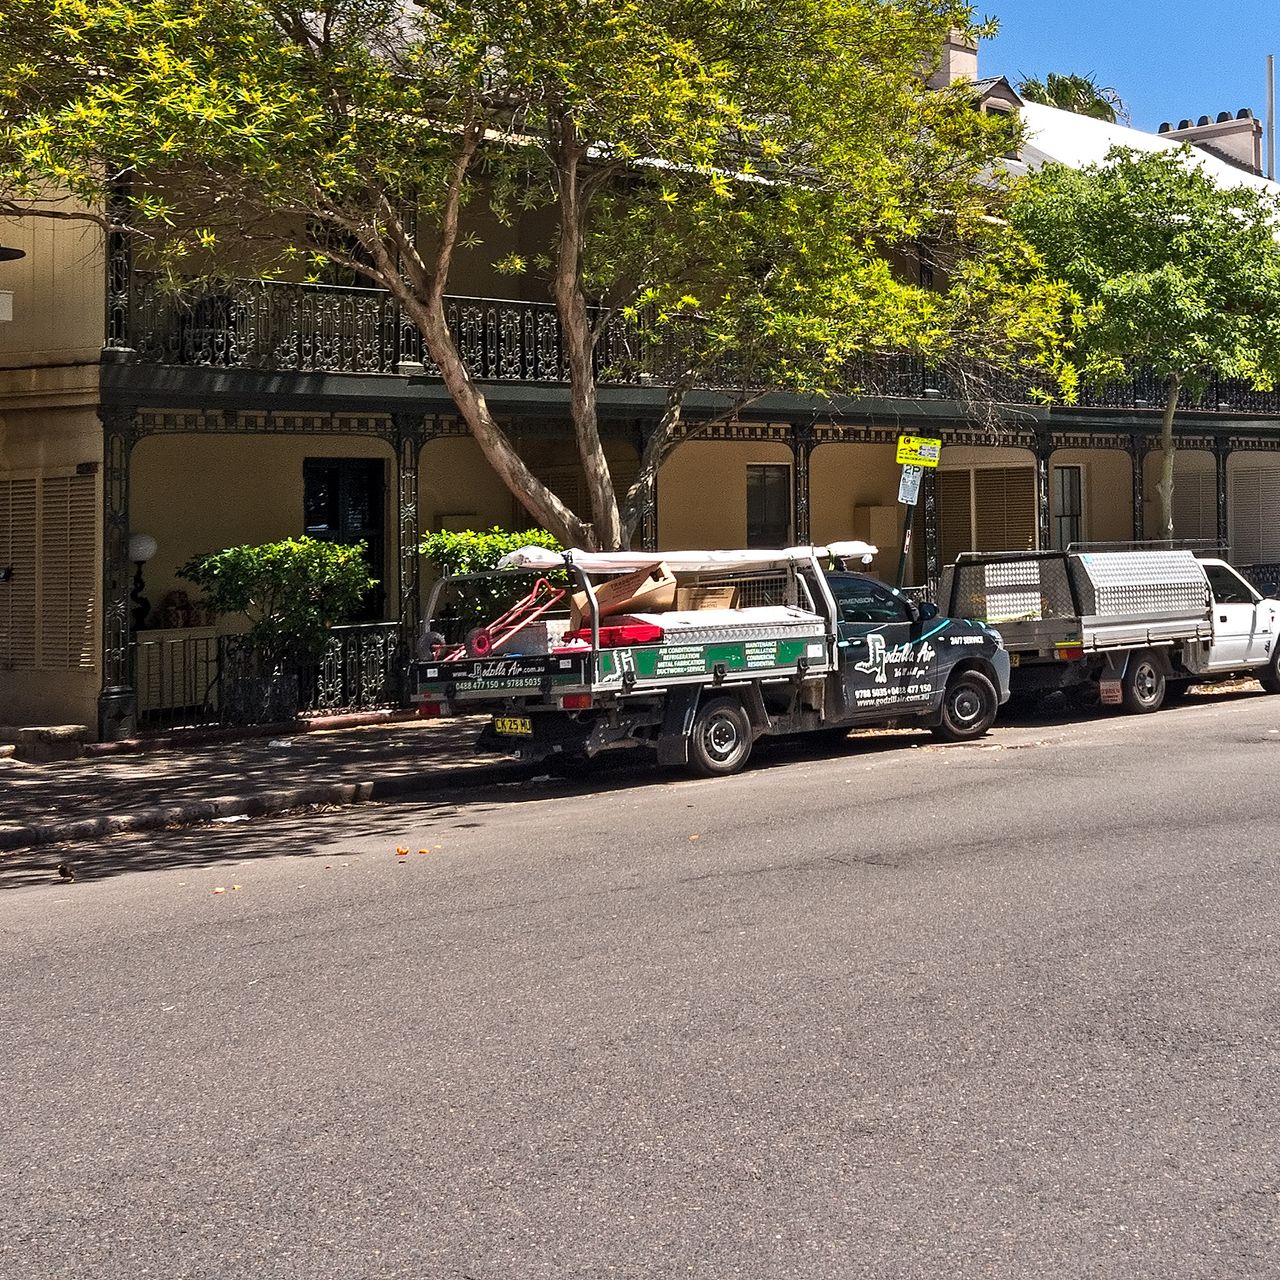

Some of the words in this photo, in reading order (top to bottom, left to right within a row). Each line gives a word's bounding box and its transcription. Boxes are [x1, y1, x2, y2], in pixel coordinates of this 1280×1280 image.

[963, 635, 984, 645] SERVICE
[668, 646, 704, 654] CONDITIONING
[917, 641, 936, 663] Air
[455, 682, 472, 690] 0488
[472, 681, 485, 689] 477
[486, 680, 499, 688] 150
[506, 679, 524, 688] 9788
[524, 677, 541, 686] 5035
[907, 685, 919, 693] 477
[920, 683, 932, 693] 150
